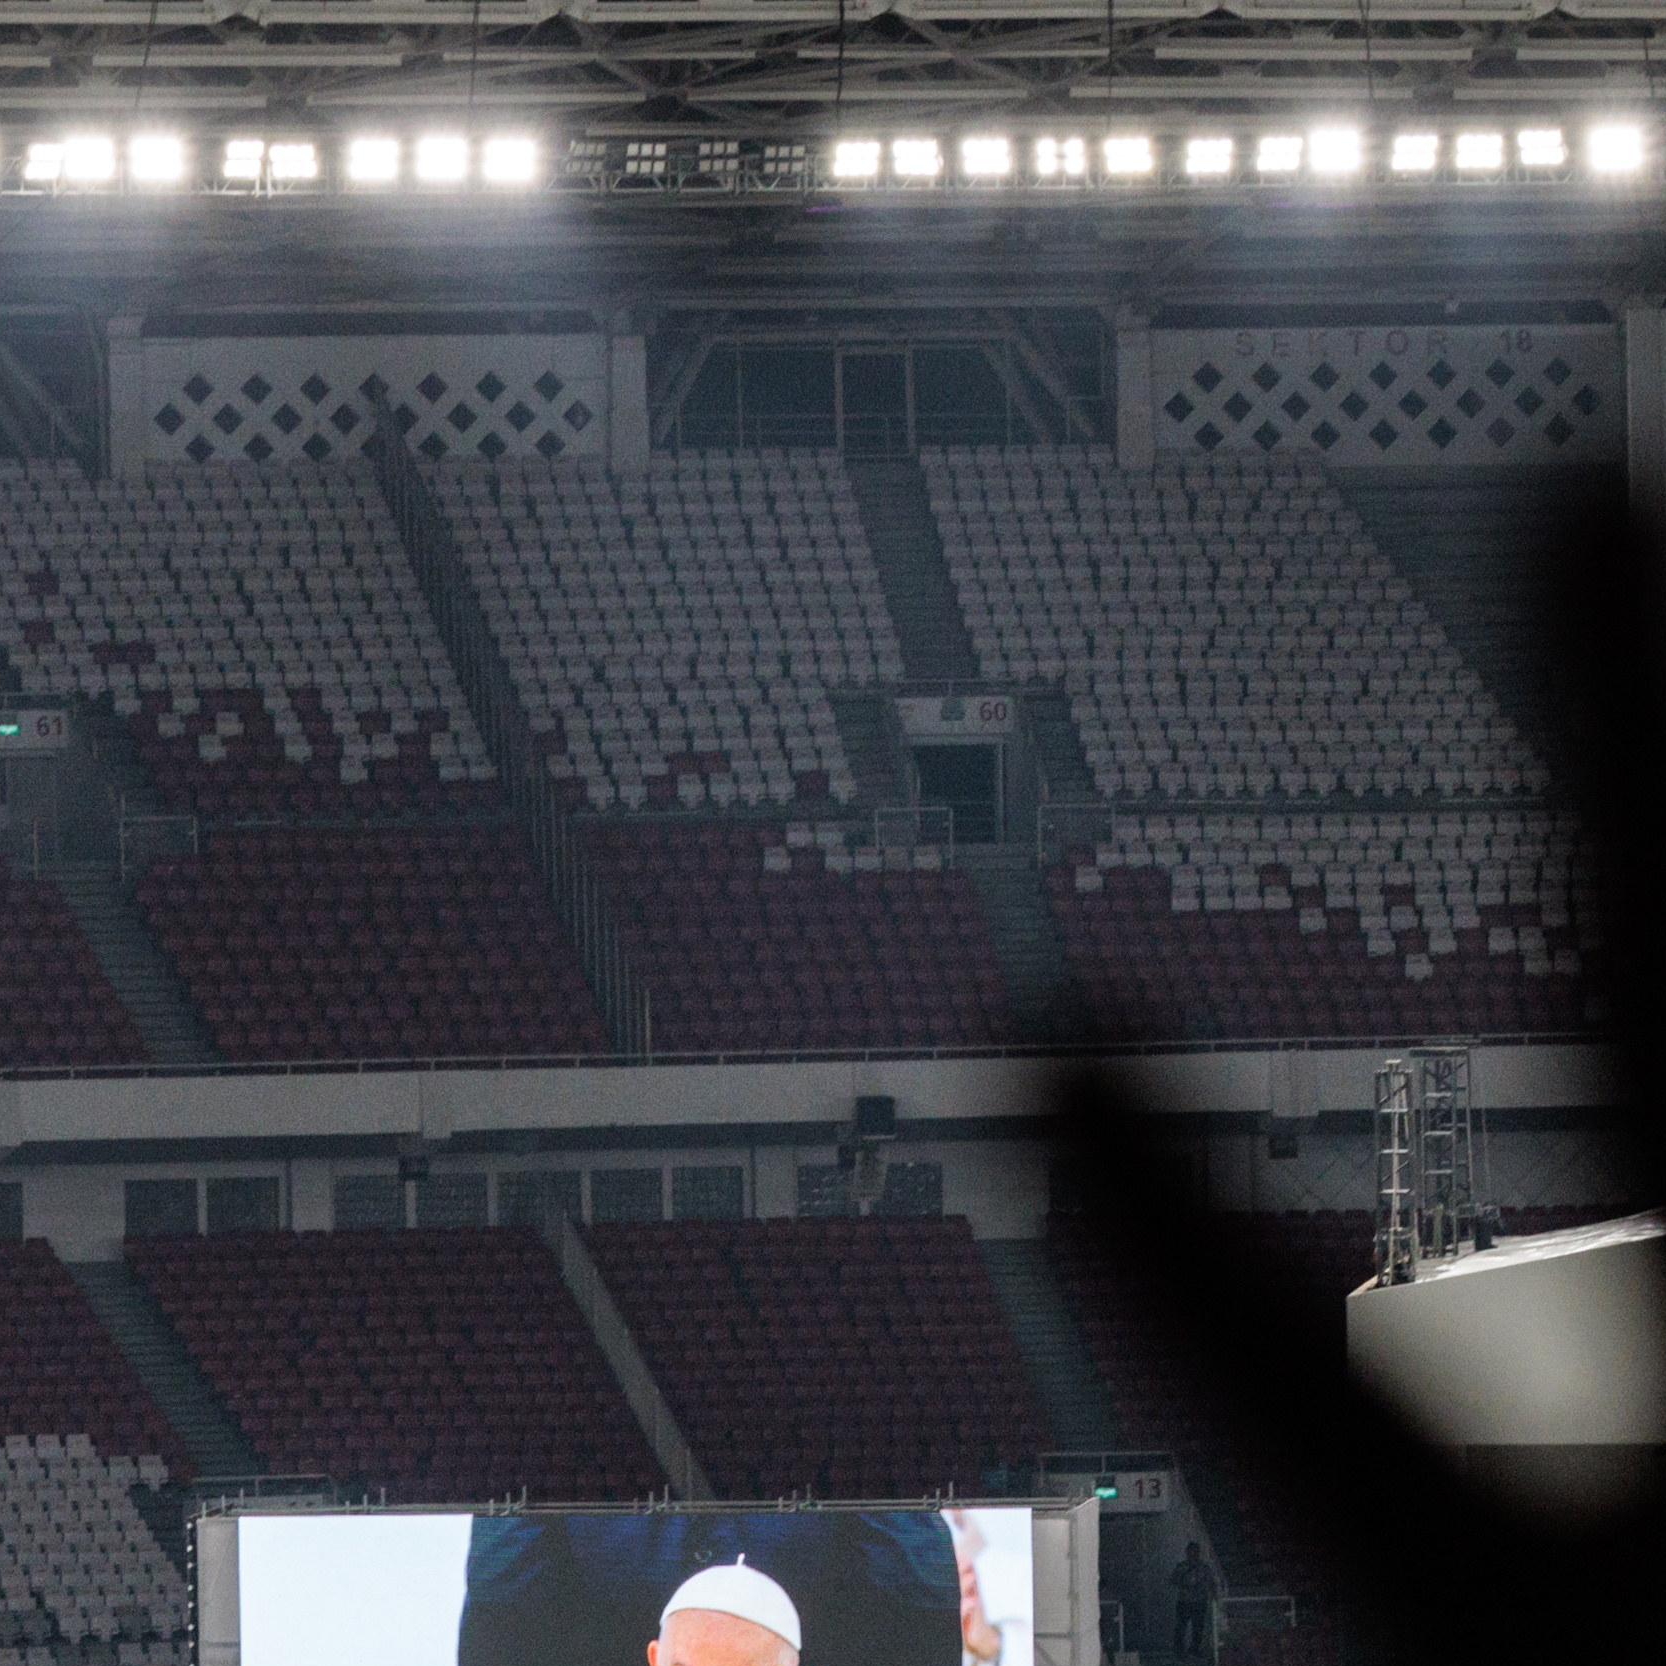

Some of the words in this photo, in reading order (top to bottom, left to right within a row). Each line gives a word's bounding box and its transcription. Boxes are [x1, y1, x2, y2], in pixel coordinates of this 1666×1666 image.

[1234, 329, 1450, 358] SEKTOR
[978, 701, 1008, 722] 60
[36, 715, 63, 737] 61
[1134, 1477, 1162, 1499] 13
